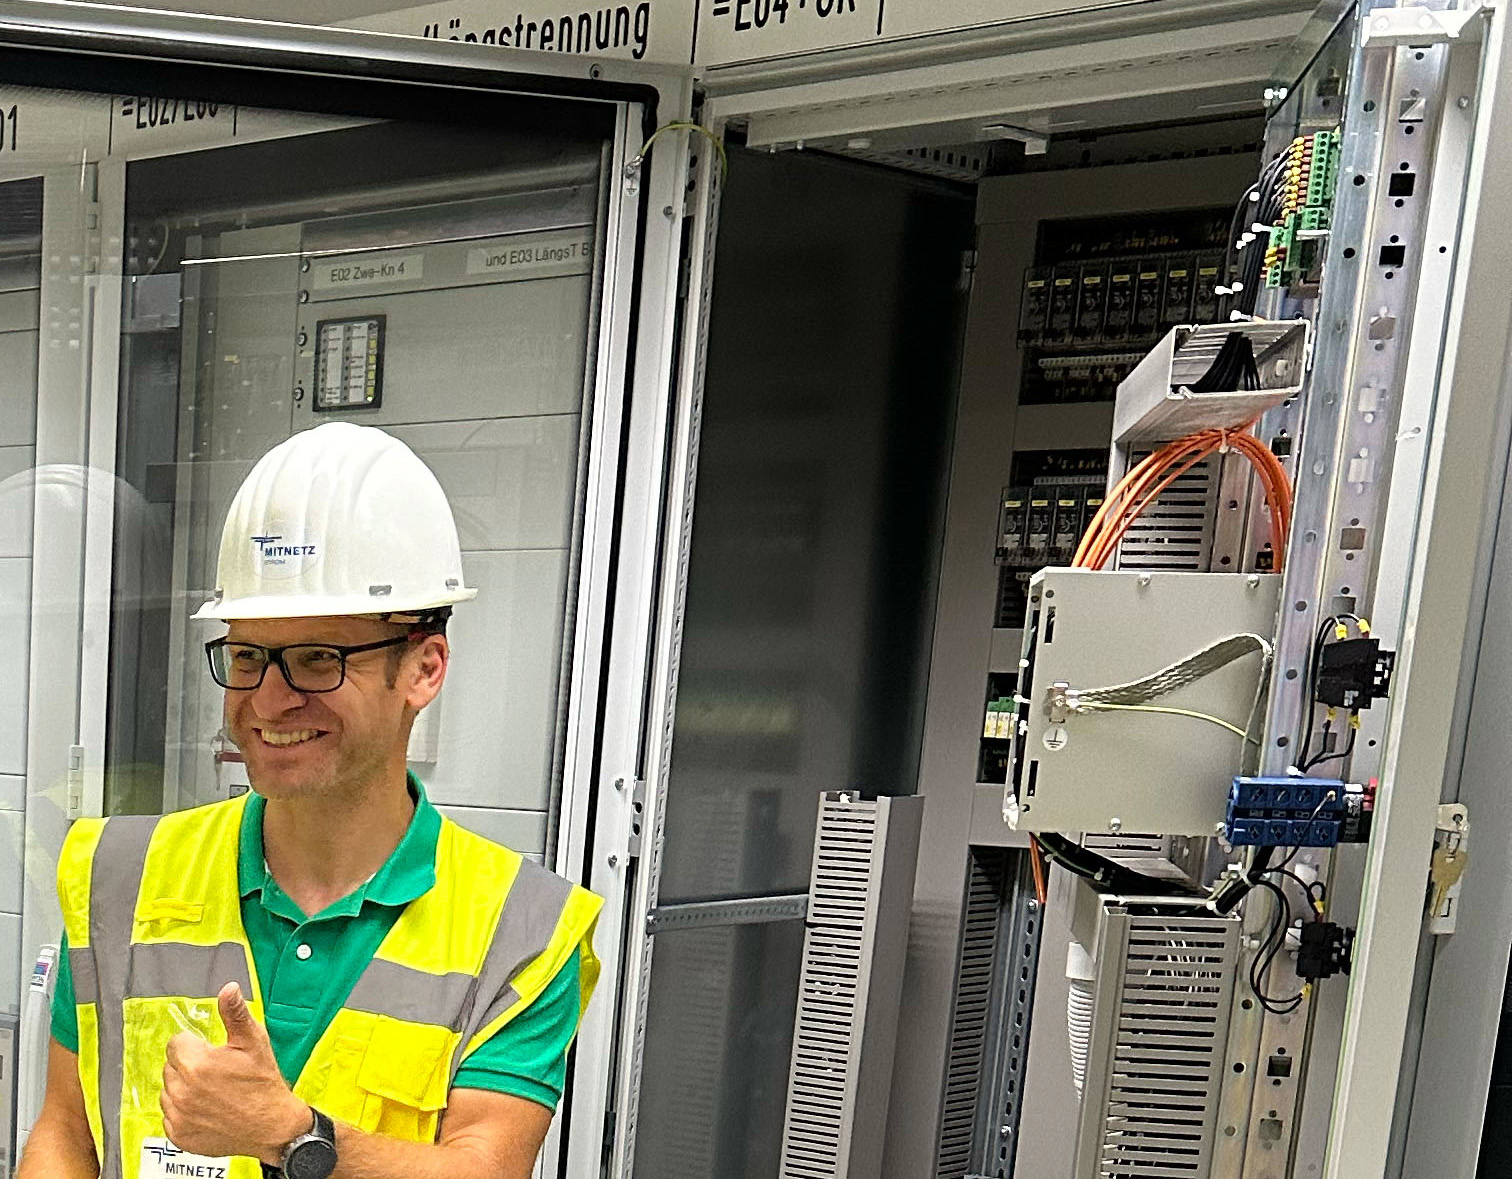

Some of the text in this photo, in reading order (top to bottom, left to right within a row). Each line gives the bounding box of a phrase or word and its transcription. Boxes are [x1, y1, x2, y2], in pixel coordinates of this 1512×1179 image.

[486, 252, 507, 267] und
[510, 249, 533, 265] E03
[331, 268, 350, 282] E02
[265, 546, 316, 556] MITNETZ
[165, 1163, 226, 1179] MITNETZ
